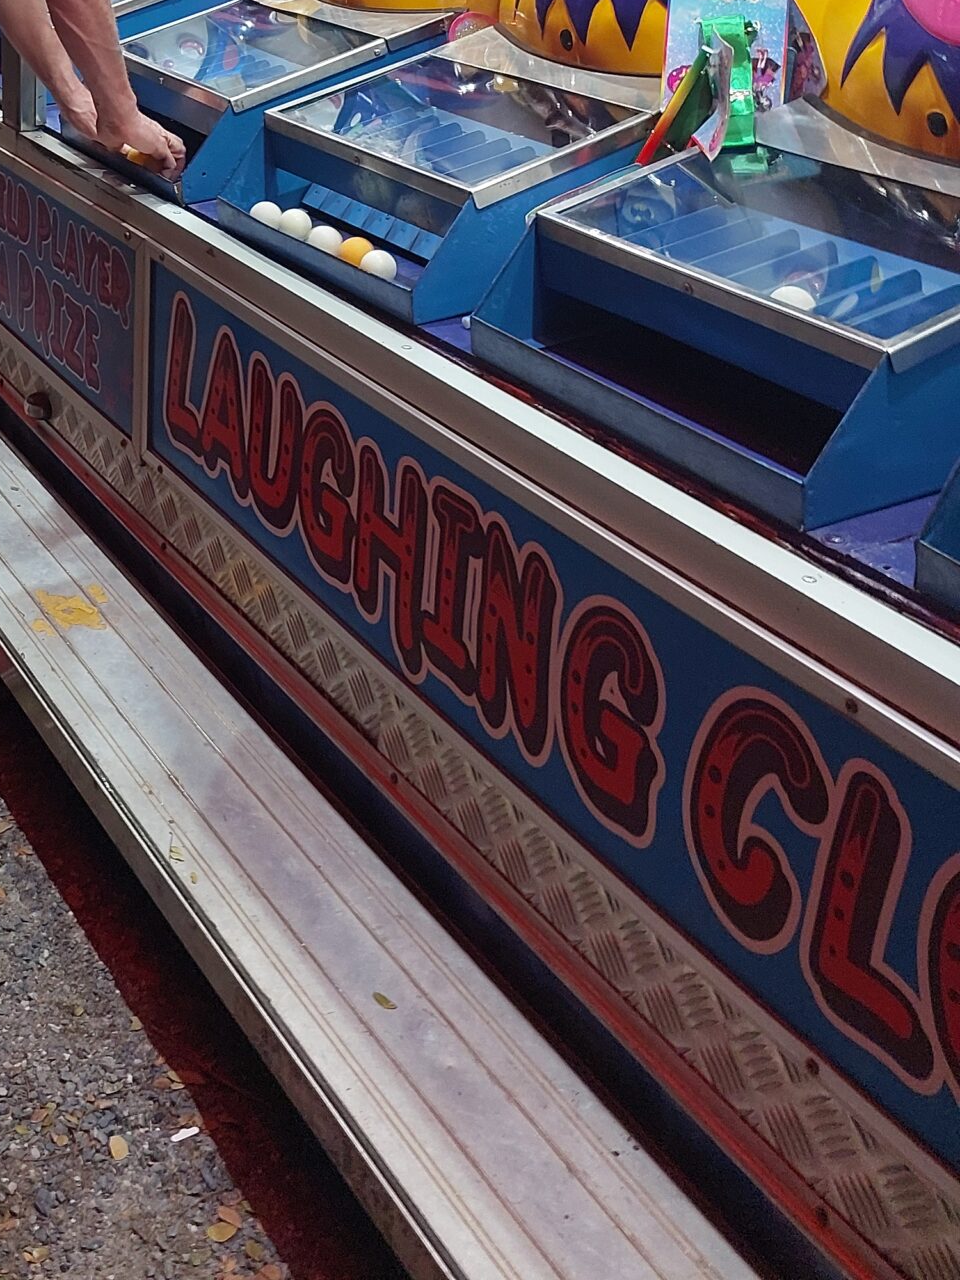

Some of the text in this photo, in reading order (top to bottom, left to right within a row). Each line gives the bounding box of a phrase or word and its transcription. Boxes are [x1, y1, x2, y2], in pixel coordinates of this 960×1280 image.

[17, 249, 102, 394] PRIZE
[36, 195, 132, 330] PLAYER
[163, 290, 667, 849] LAUGHING
